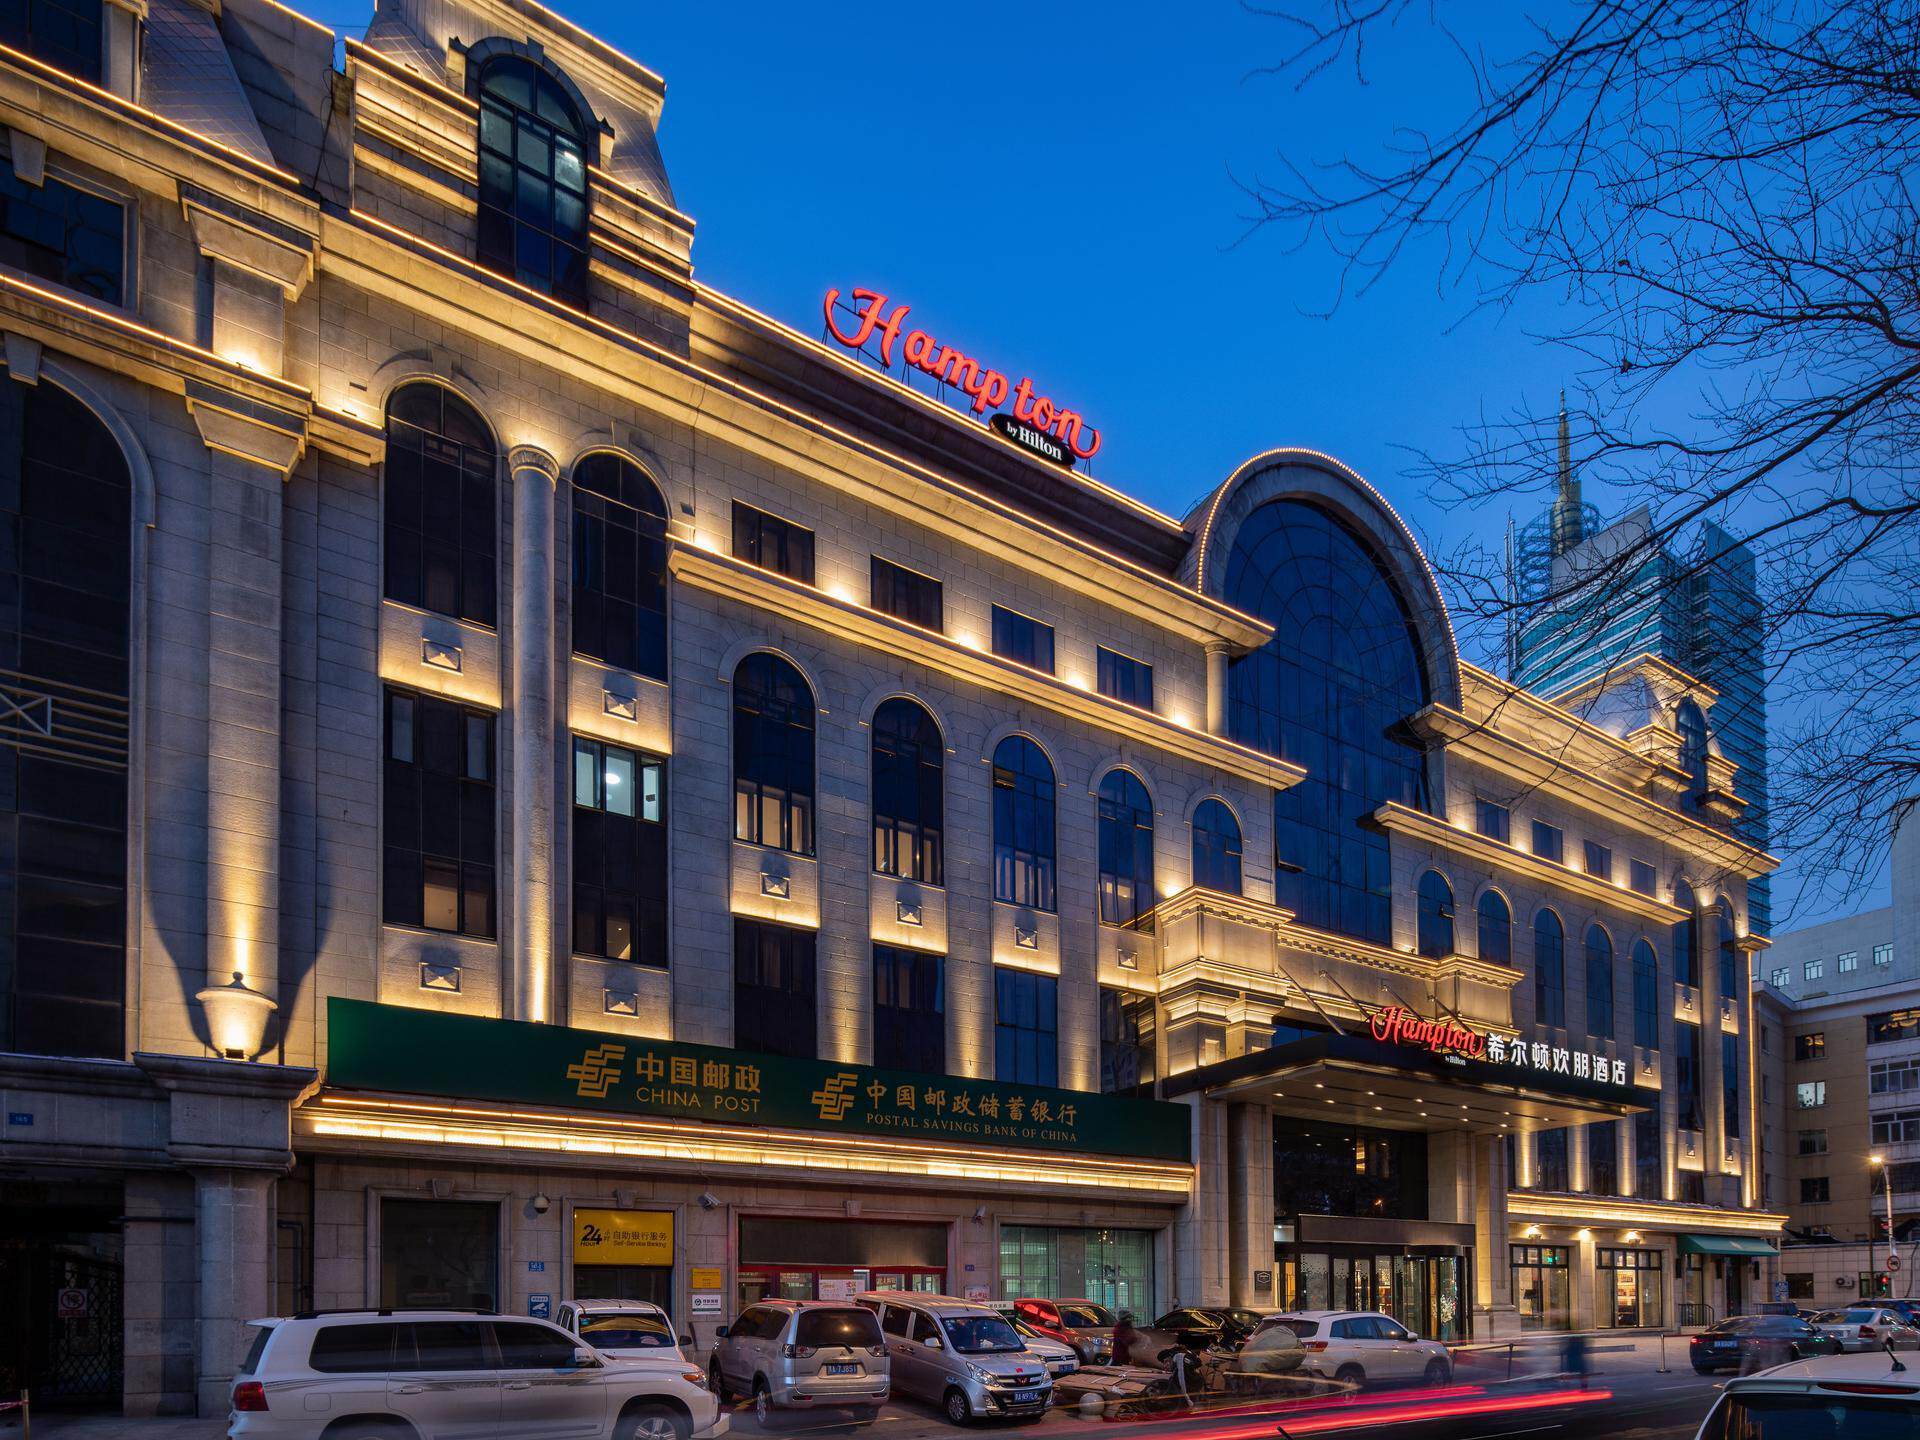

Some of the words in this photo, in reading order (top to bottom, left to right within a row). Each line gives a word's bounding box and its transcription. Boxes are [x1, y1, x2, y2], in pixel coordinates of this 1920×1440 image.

[824, 287, 1101, 460] Hampton
[1006, 422, 1018, 441] by
[1018, 424, 1062, 461] Hilton
[1370, 1005, 1484, 1056] Hampton
[636, 1052, 761, 1094] 中国邮政
[1487, 1033, 1626, 1085] 希尔顿欢朋酒店
[636, 1087, 701, 1108] CHINA
[714, 1095, 760, 1113] POST
[866, 1079, 1077, 1127] 中国邮政储蓄银行
[867, 1113, 918, 1128] POSTAL
[924, 1118, 979, 1133] SAVINGS
[984, 1124, 1017, 1137] BANK
[1022, 1128, 1036, 1138] OF
[1041, 1130, 1077, 1142] CHINA
[580, 1224, 602, 1245] 24
[613, 1231, 667, 1241] 自助银行服务
